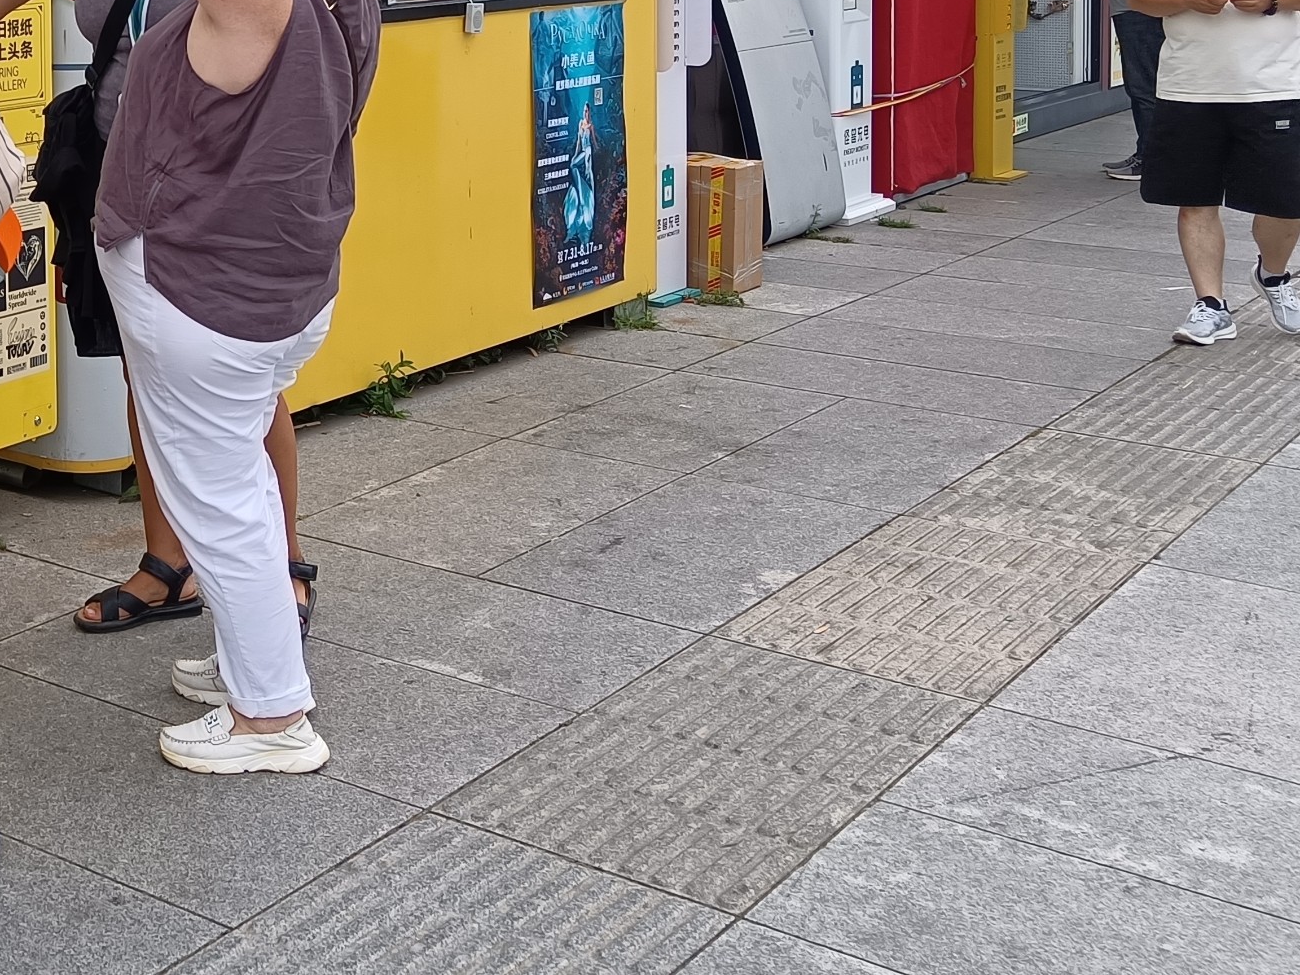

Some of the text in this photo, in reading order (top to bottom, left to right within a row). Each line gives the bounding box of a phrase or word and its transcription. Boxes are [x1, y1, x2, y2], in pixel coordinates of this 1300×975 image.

[561, 51, 595, 69] 小美人鱼
[8, 288, 37, 301] Worldwide
[8, 298, 27, 310] Spread
